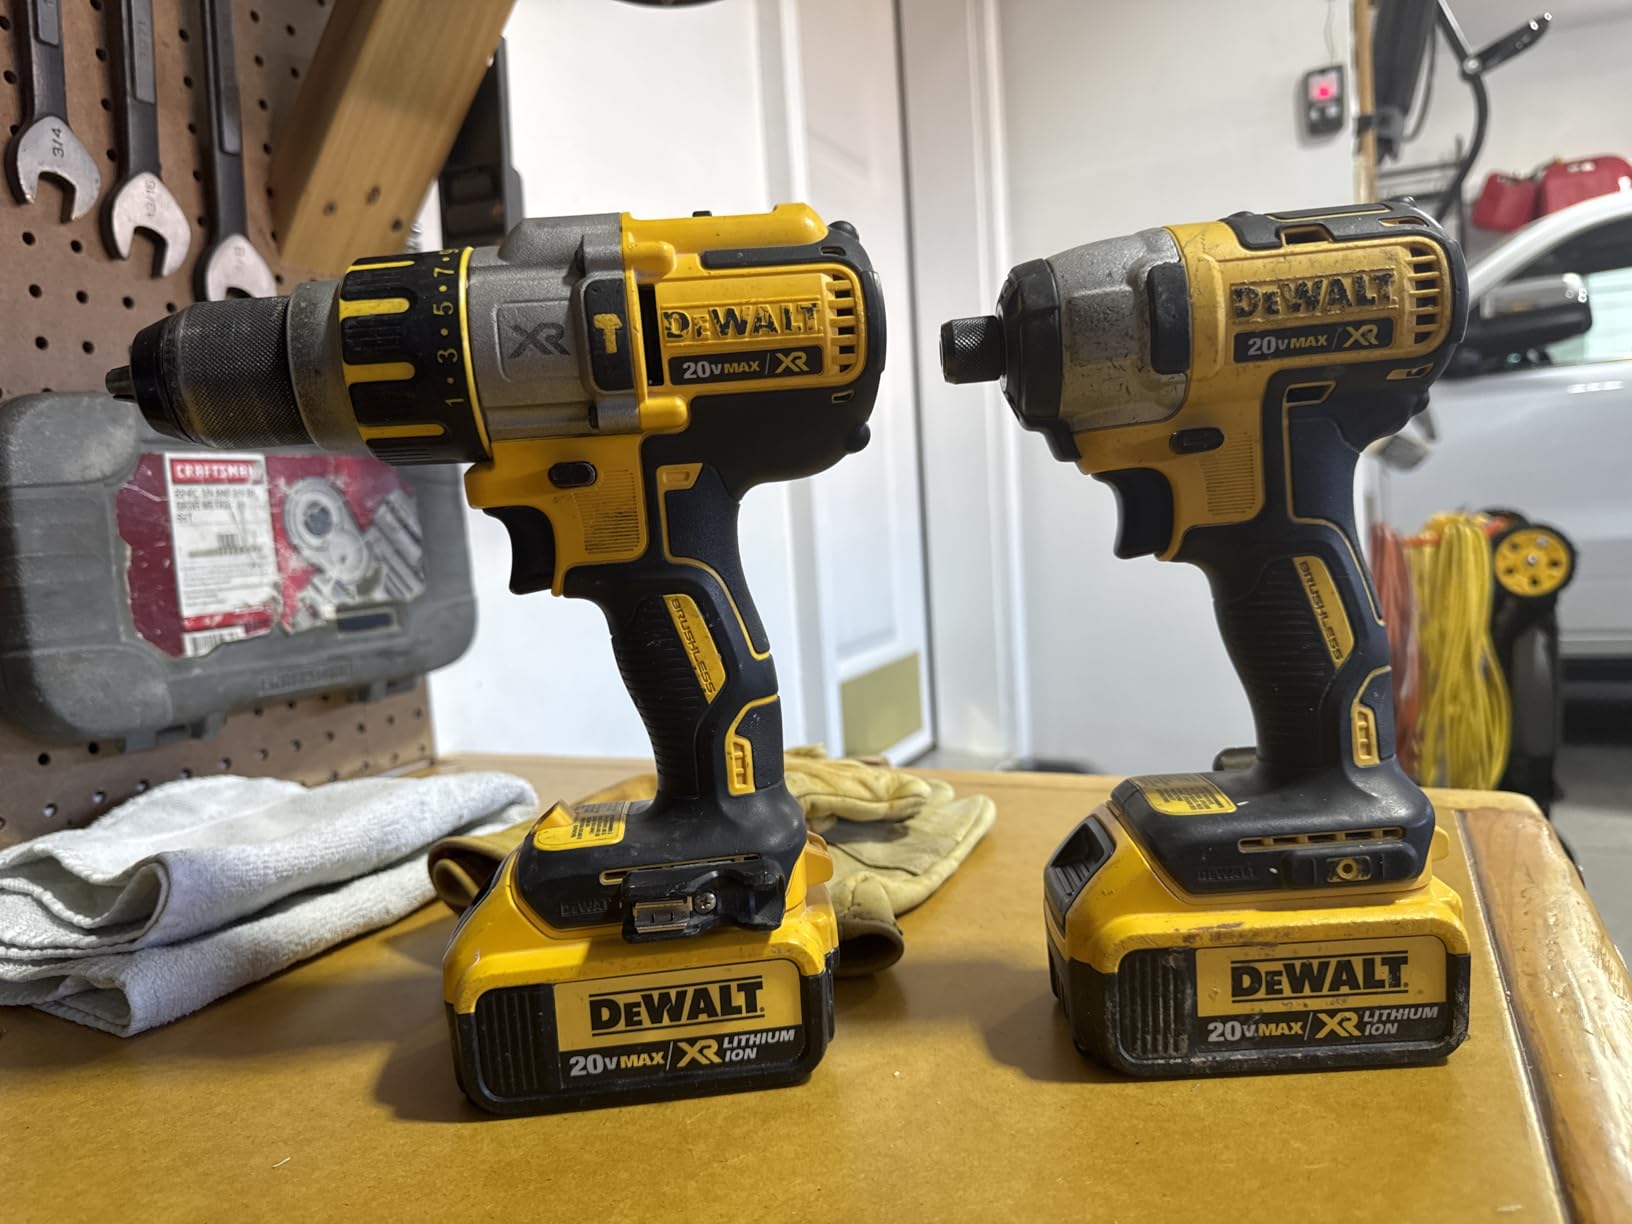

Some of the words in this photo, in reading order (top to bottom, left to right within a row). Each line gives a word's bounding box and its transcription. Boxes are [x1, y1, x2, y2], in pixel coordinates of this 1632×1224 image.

[51, 127, 65, 159] 3/4
[433, 267, 455, 278] 7
[433, 301, 454, 316] 5
[507, 321, 572, 360] XR
[1289, 334, 1329, 348] MAX
[1343, 323, 1380, 348] XR
[436, 349, 459, 364] 3
[723, 360, 761, 374] MAX
[775, 351, 811, 374] XR
[444, 398, 465, 406] 1
[1299, 560, 1344, 660] BRUSHLESS
[671, 598, 717, 694] BRUSHLESS
[1258, 1021, 1304, 1037] MAX
[1313, 1011, 1363, 1039] XR
[1363, 1006, 1440, 1023] LITHIUM
[722, 1028, 796, 1049] LITHIUM
[1364, 1022, 1399, 1036] ION
[619, 1051, 665, 1069] MAX
[676, 1038, 723, 1068] XR
[725, 1047, 758, 1062] ION
